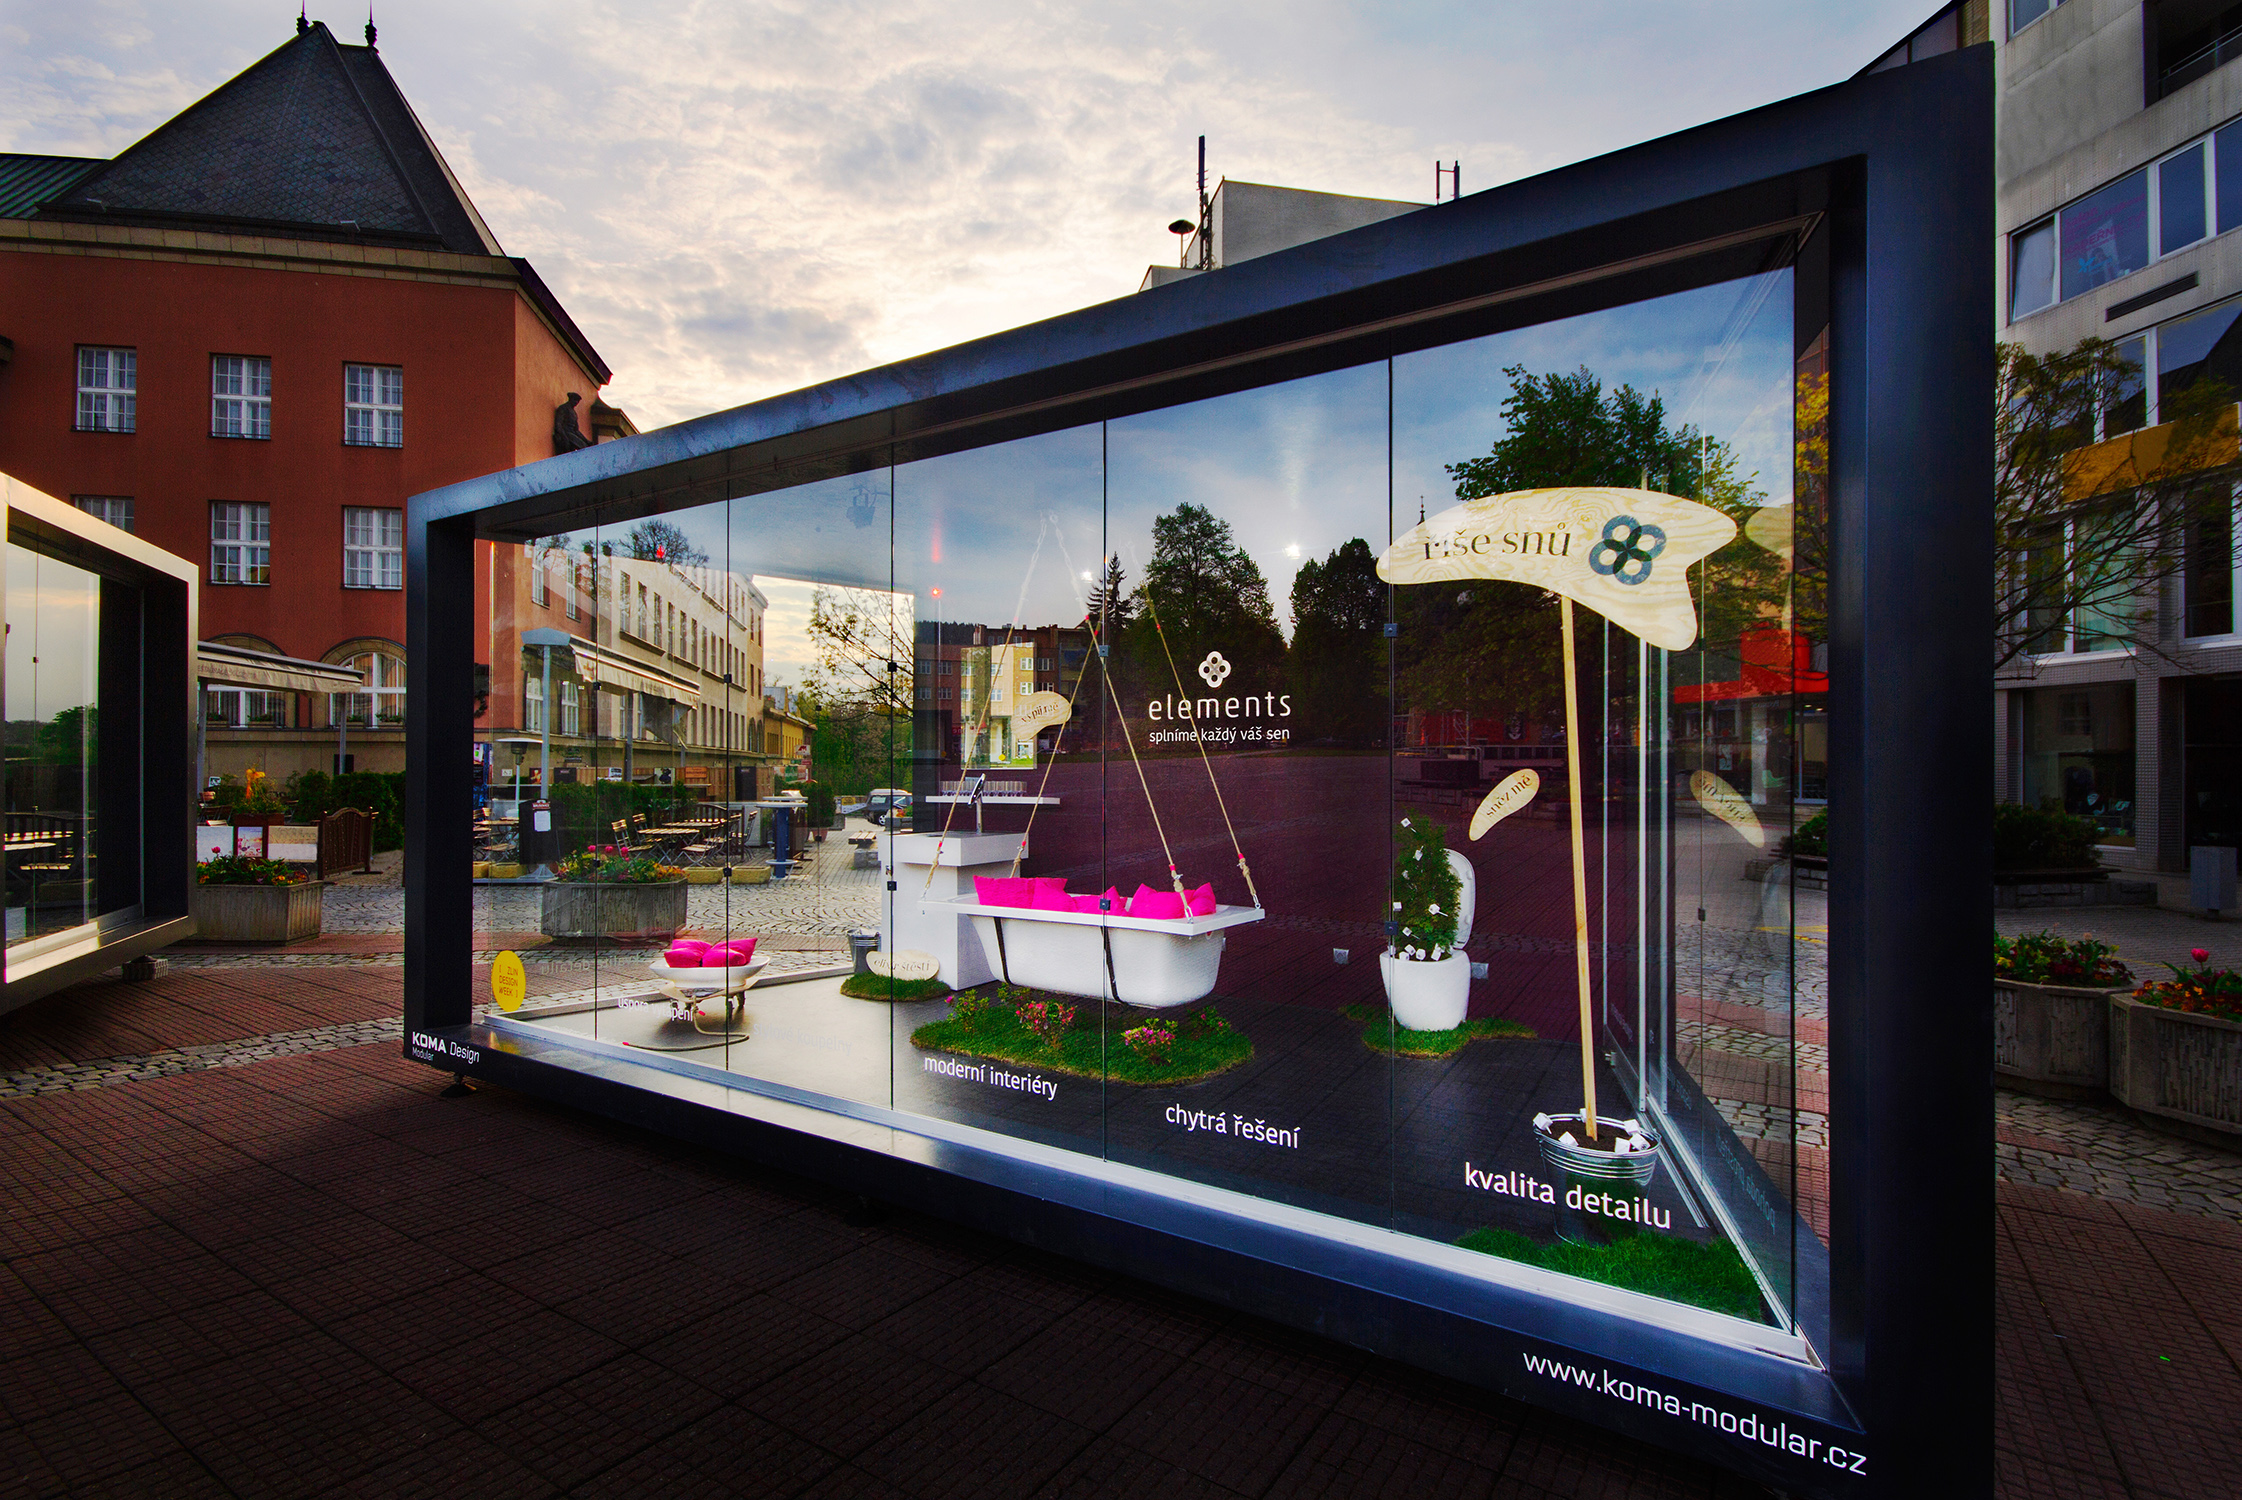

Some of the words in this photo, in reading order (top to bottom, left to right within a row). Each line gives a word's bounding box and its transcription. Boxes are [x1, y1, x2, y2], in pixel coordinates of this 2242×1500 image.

[1424, 529, 1491, 559] říše
[1502, 522, 1571, 557] snů
[1148, 691, 1292, 720] elements
[1149, 728, 1198, 744] splníme
[1201, 726, 1237, 744] každý
[1240, 726, 1262, 741] váš
[1266, 728, 1290, 741] sen
[1486, 792, 1512, 817] sněz
[1511, 774, 1533, 795] mě
[499, 975, 519, 987] DESIGN
[874, 959, 899, 971] elixr
[499, 986, 514, 997] WEEK
[412, 1031, 447, 1054] KOMA
[449, 1041, 480, 1065] Design
[412, 1046, 434, 1061] Modular
[924, 1057, 986, 1083] moderní
[990, 1066, 1058, 1101] interiéry
[1165, 1103, 1227, 1134] chytrá
[1233, 1113, 1301, 1149] řešení
[1465, 1161, 1556, 1205] kvalita
[1565, 1184, 1671, 1229] detailu
[1523, 1352, 1867, 1475] www.koma-modular.cz
